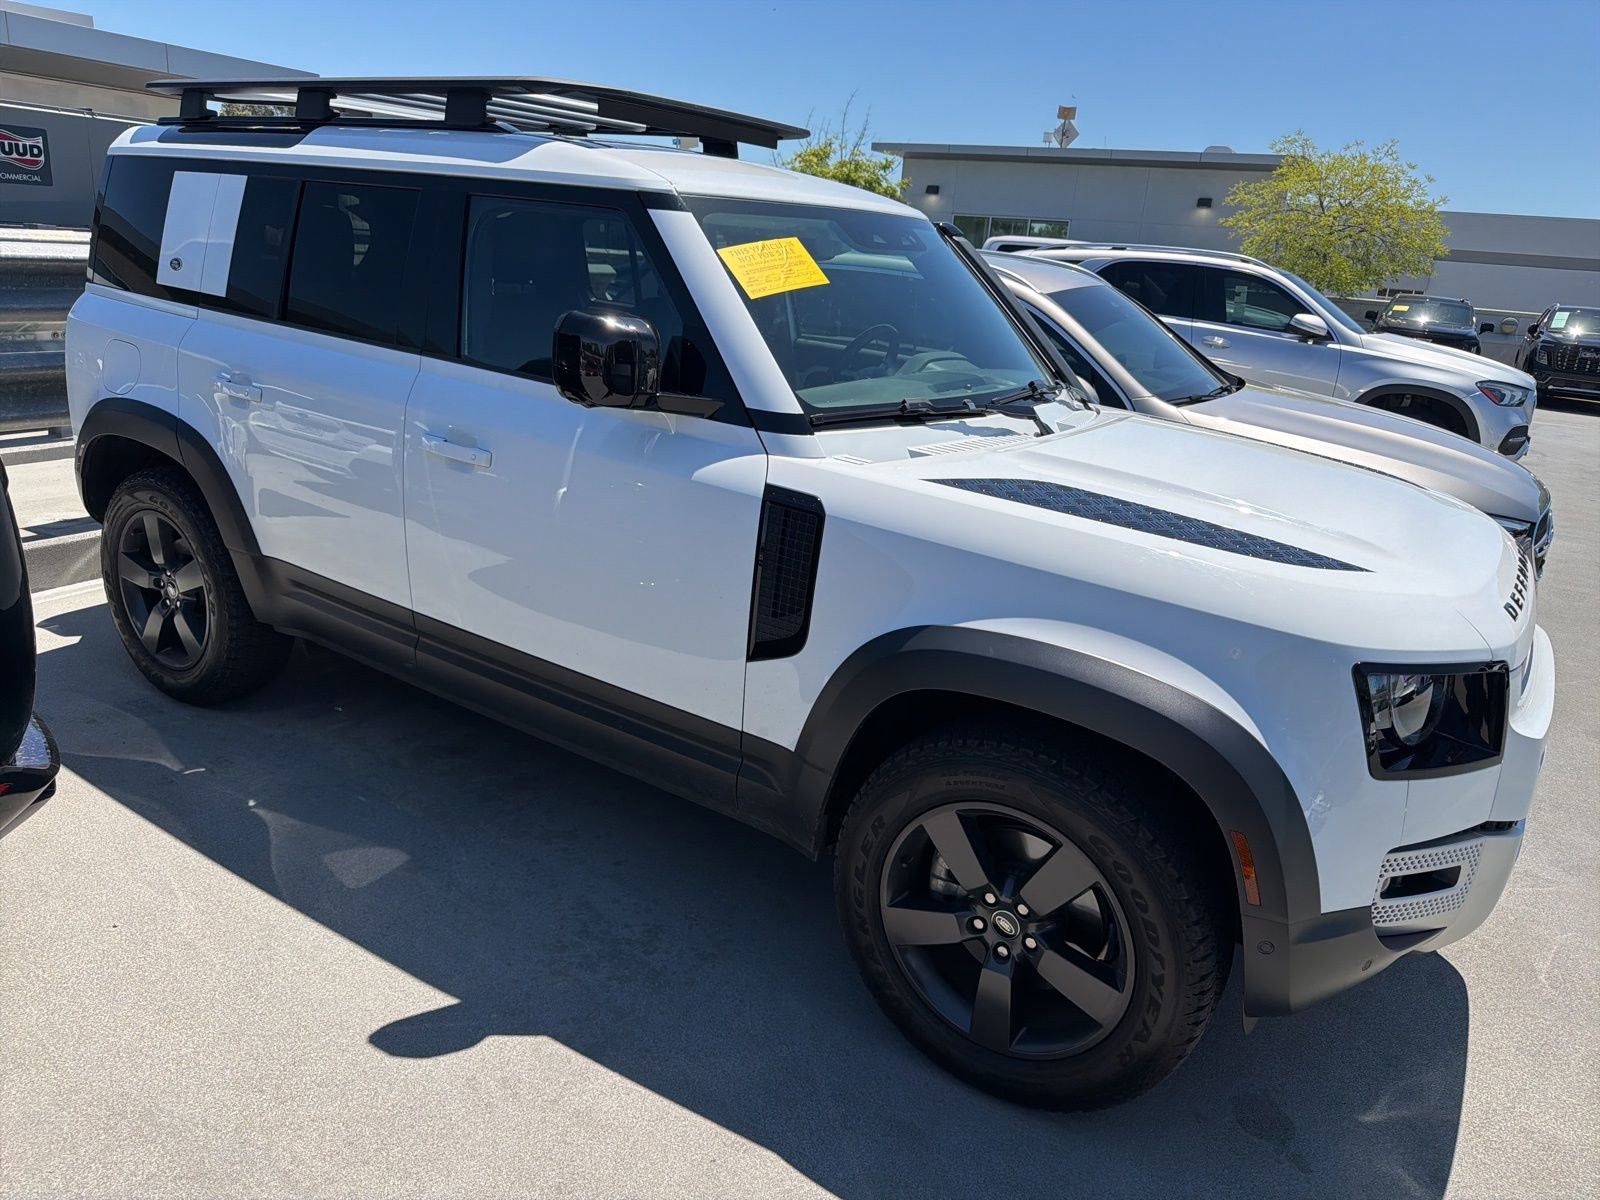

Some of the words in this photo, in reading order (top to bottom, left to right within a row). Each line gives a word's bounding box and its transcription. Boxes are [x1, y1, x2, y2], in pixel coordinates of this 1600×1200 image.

[0, 172, 41, 182] OMMERCIAL
[728, 247, 750, 256] THIS
[1087, 833, 1168, 1064] GOODYEAR
